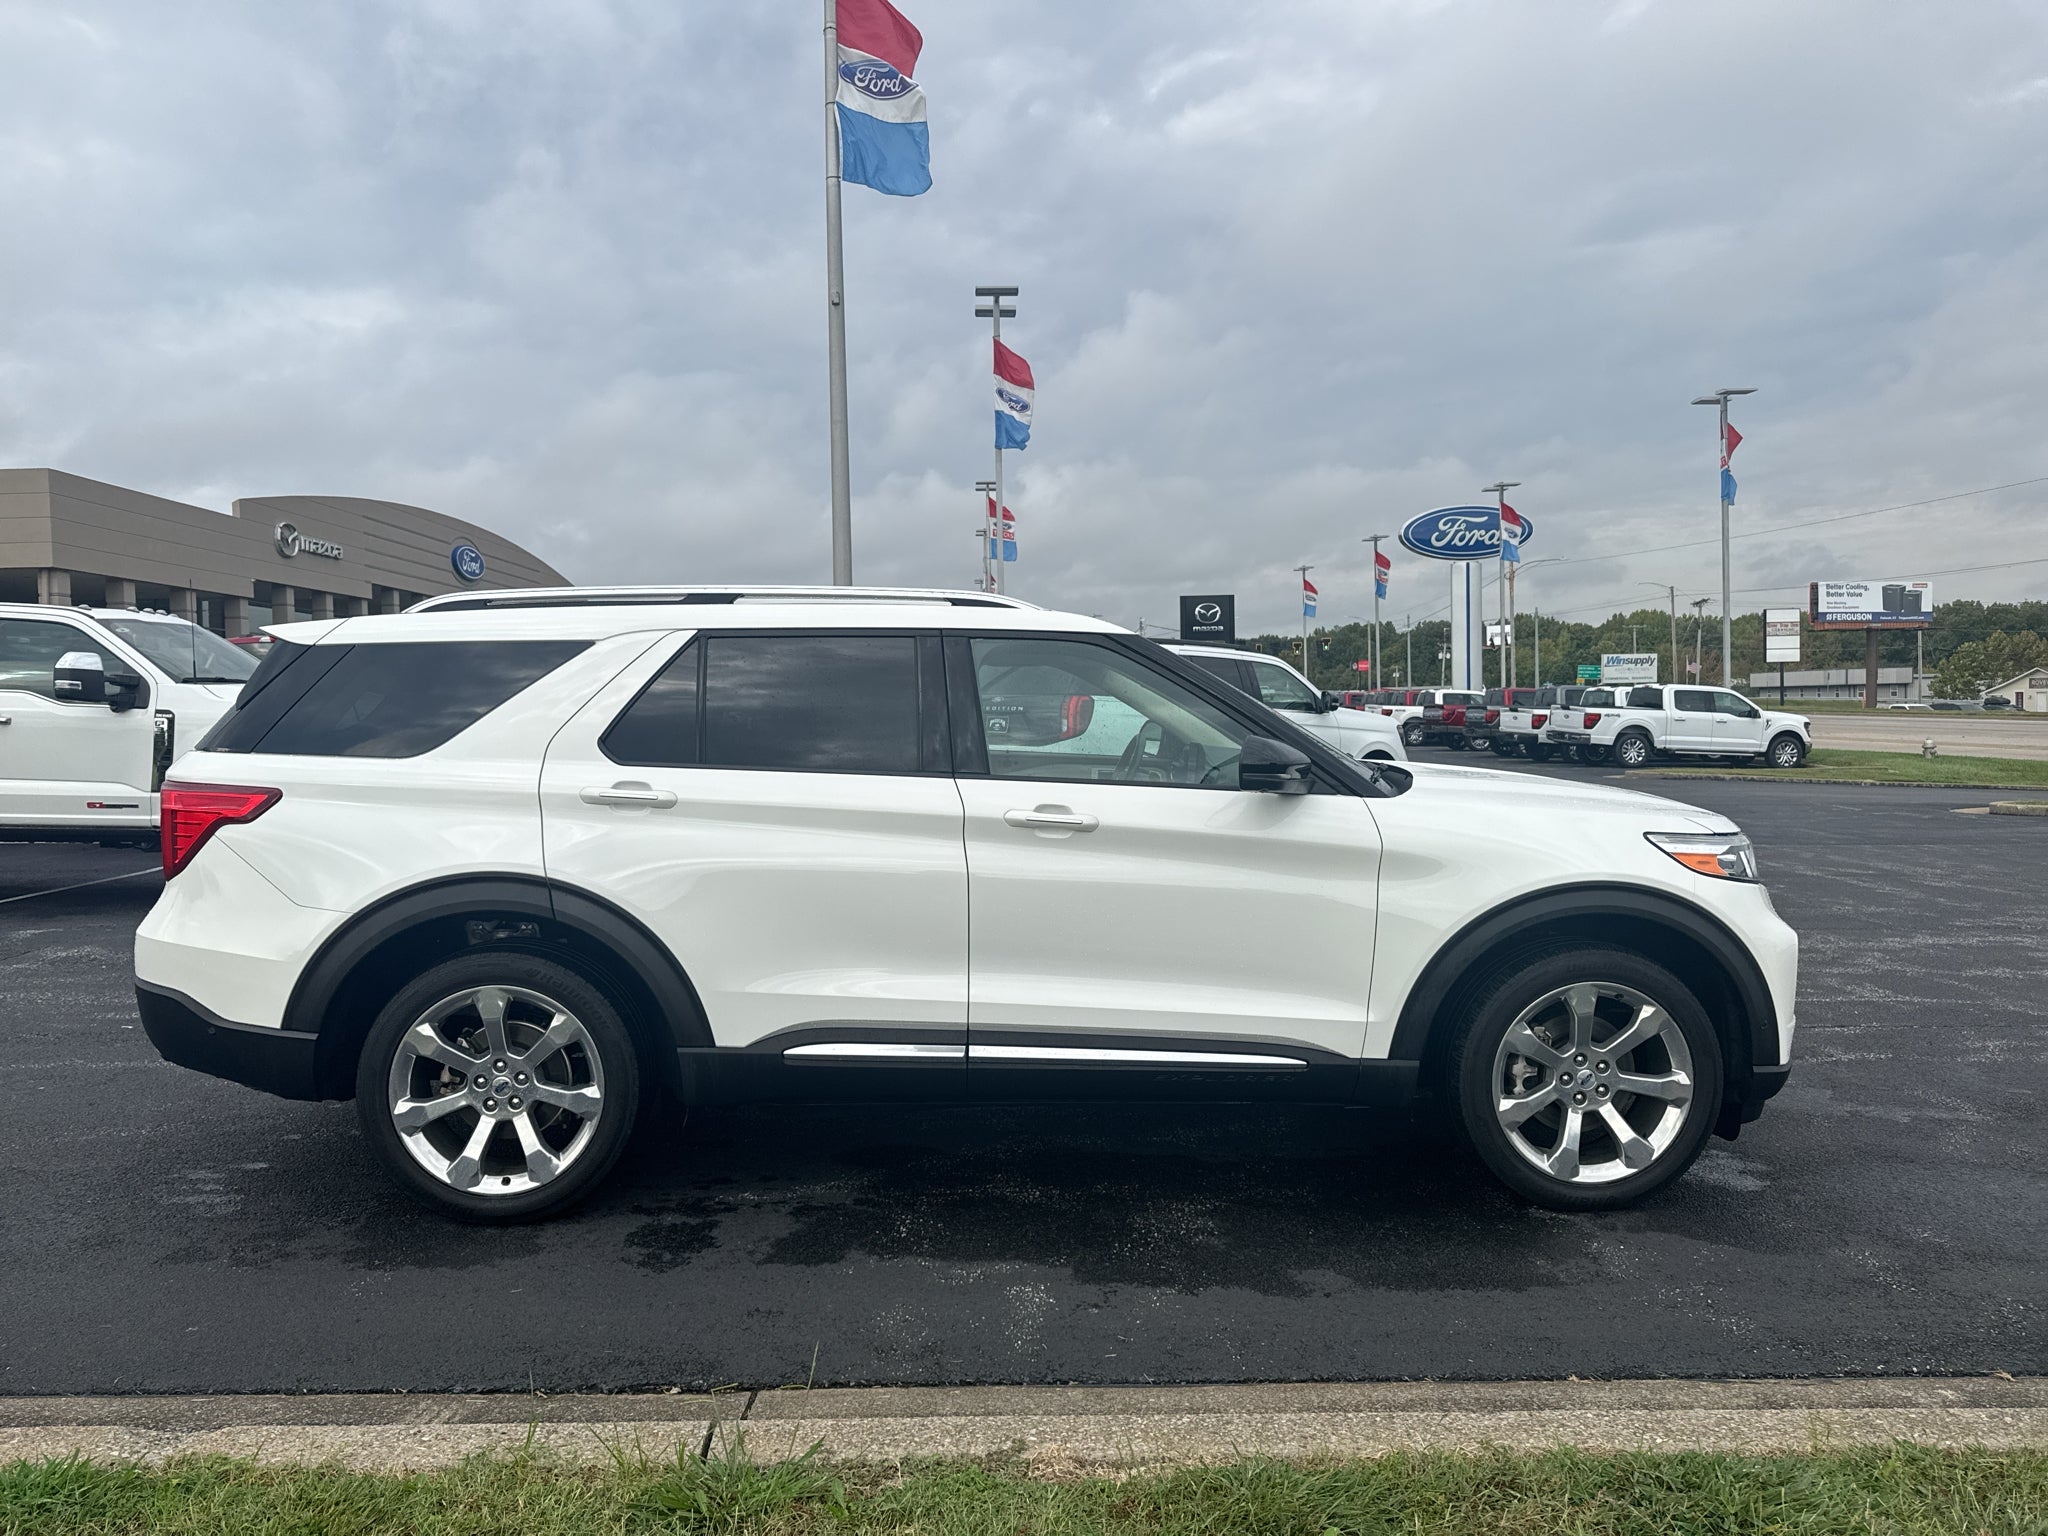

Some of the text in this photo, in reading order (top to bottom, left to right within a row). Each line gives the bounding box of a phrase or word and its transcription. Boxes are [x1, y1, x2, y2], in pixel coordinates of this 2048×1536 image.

[854, 66, 903, 93] Ford
[301, 535, 344, 559] mazda
[462, 550, 481, 574] Ford
[1845, 583, 1870, 592] Cooling,
[1832, 613, 1873, 621] FERGUSON
[1606, 655, 1656, 667] Winsupply
